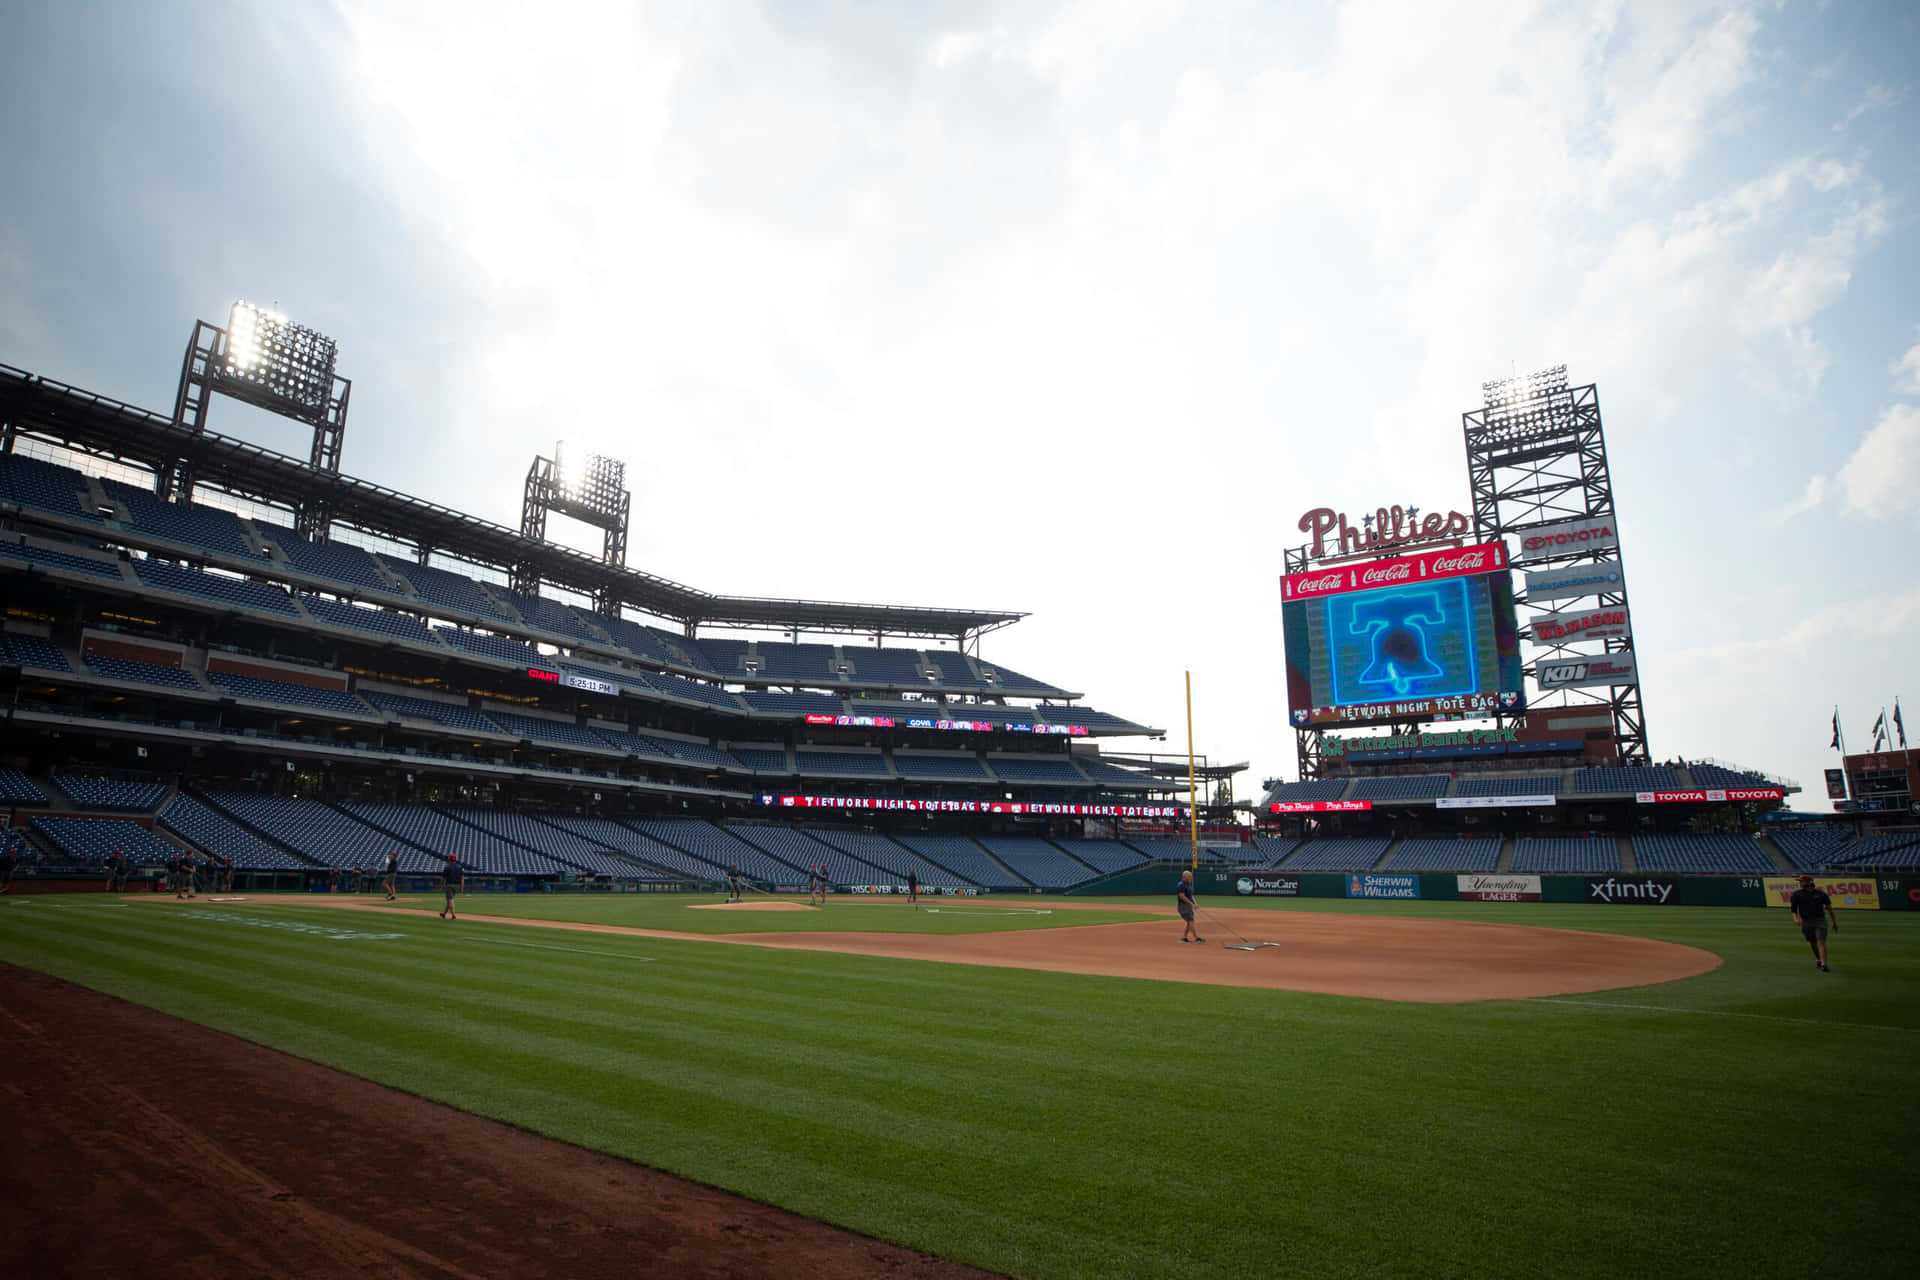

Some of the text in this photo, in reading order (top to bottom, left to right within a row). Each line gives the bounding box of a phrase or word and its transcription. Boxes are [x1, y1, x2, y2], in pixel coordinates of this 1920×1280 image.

[1298, 504, 1468, 558] Phillies
[1546, 527, 1612, 546] TOYOTA
[1433, 552, 1485, 573] Coca-Cola
[1363, 563, 1411, 584] Coca-Cola
[1297, 574, 1343, 593] Coca-Cola
[528, 669, 560, 682] GIANT
[569, 678, 611, 693] 5:25:11 PM
[1340, 705, 1391, 718] NETWORK
[1396, 702, 1431, 714] NIGHT
[1435, 699, 1465, 710] TOTE
[1347, 726, 1518, 751] Citizens Bank Park
[1656, 792, 1705, 801] TOYOTA
[1728, 791, 1779, 799] TOYOTA
[875, 799, 911, 809] NIGHT
[919, 800, 947, 810] TOTE
[1082, 805, 1115, 815] NIGHT
[1254, 878, 1298, 890] NovaCare
[1364, 875, 1412, 887] SHERWIN
[1472, 877, 1530, 892] Yuengling
[851, 885, 891, 894] DISCOVER
[898, 885, 935, 894] DISOVER
[1481, 892, 1518, 901] LAGER
[1591, 878, 1672, 903] xfinity
